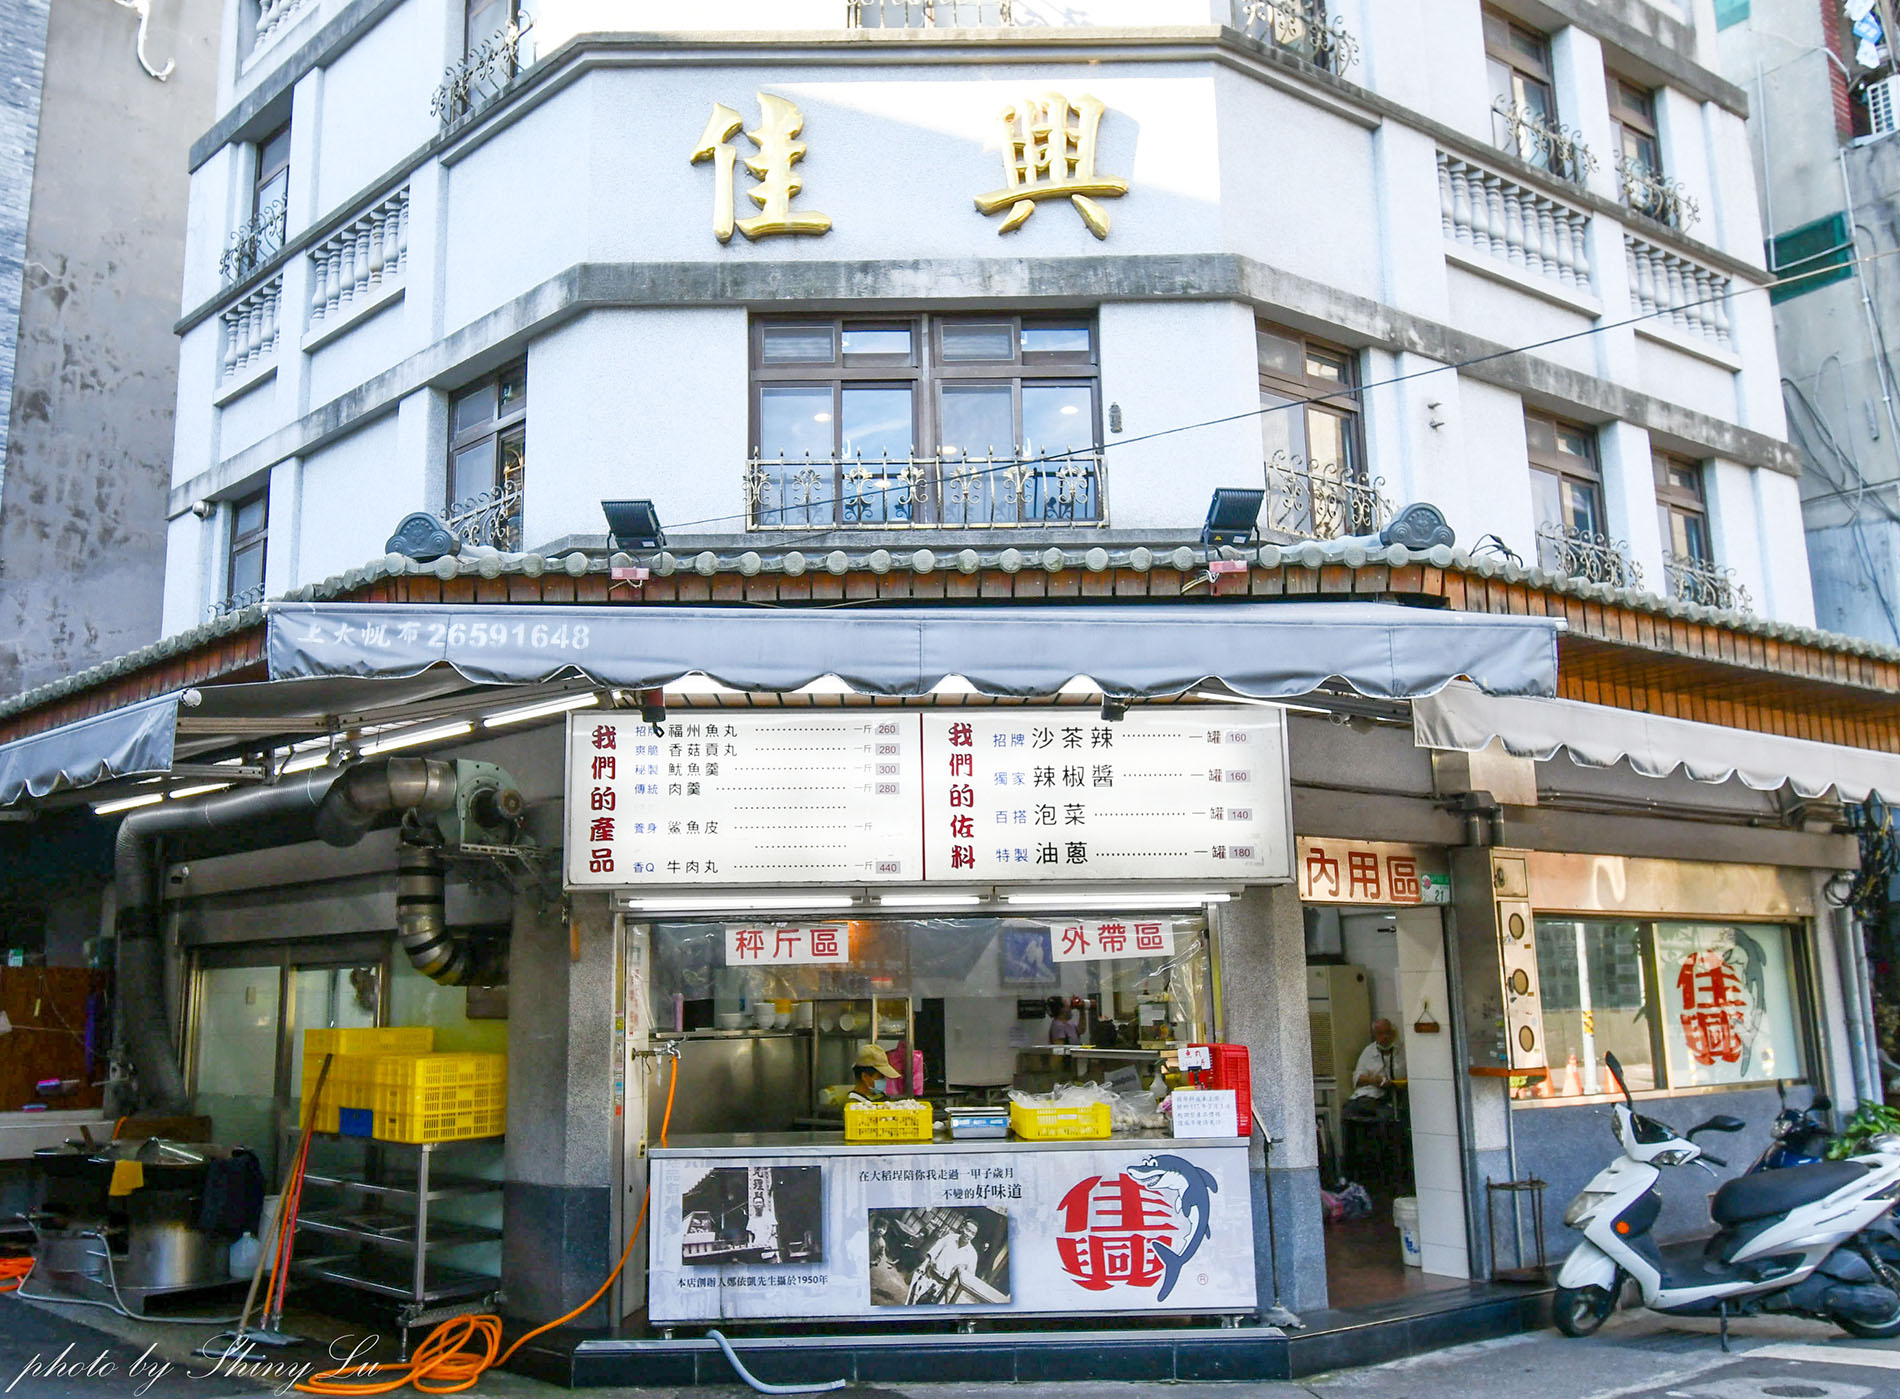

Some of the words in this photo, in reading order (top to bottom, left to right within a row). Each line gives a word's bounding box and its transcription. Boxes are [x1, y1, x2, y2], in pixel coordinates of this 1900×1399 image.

[690, 92, 1129, 243] 佳興
[297, 622, 421, 648] 上大帆布
[427, 623, 590, 650] 26591648
[668, 724, 738, 738] 福州魚丸
[878, 725, 896, 734] 260
[993, 733, 1025, 748] 招牌
[1032, 726, 1113, 749] 沙茶辣
[1230, 733, 1247, 742] 160
[635, 745, 659, 756] 爽脆
[669, 743, 738, 757] 香菇貢丸
[879, 745, 896, 754] 280
[668, 762, 719, 776] 魷魚羹
[879, 765, 896, 774] 300
[994, 771, 1026, 786] 獨家
[1033, 764, 1114, 788] 辣椒醬
[1230, 772, 1247, 781] 160
[589, 725, 616, 873] 我們的產品
[635, 784, 658, 795] 傳統
[669, 782, 701, 796] 肉羹
[879, 784, 896, 793] 280
[948, 722, 975, 869] 我們的佐料
[995, 810, 1027, 824] 百搭
[1034, 803, 1086, 826] 泡菜
[1232, 810, 1249, 820] 140
[634, 823, 657, 834] 養身
[668, 820, 719, 835] 鯊魚皮
[995, 848, 1029, 863] 特製
[1036, 841, 1088, 864] 油蔥
[1234, 848, 1251, 858] 180
[633, 861, 655, 873] 香Q
[667, 859, 719, 874] 牛肉丸
[879, 863, 897, 873] 440
[1306, 848, 1422, 902] 內用區
[735, 928, 839, 959] 秤斤區
[1061, 922, 1165, 955] 外帶區
[859, 1168, 1015, 1182] 在大稻埕陪你我走過一甲子歲月
[943, 1183, 1023, 1200] 不變的好味道
[1056, 1172, 1179, 1291] 佳興
